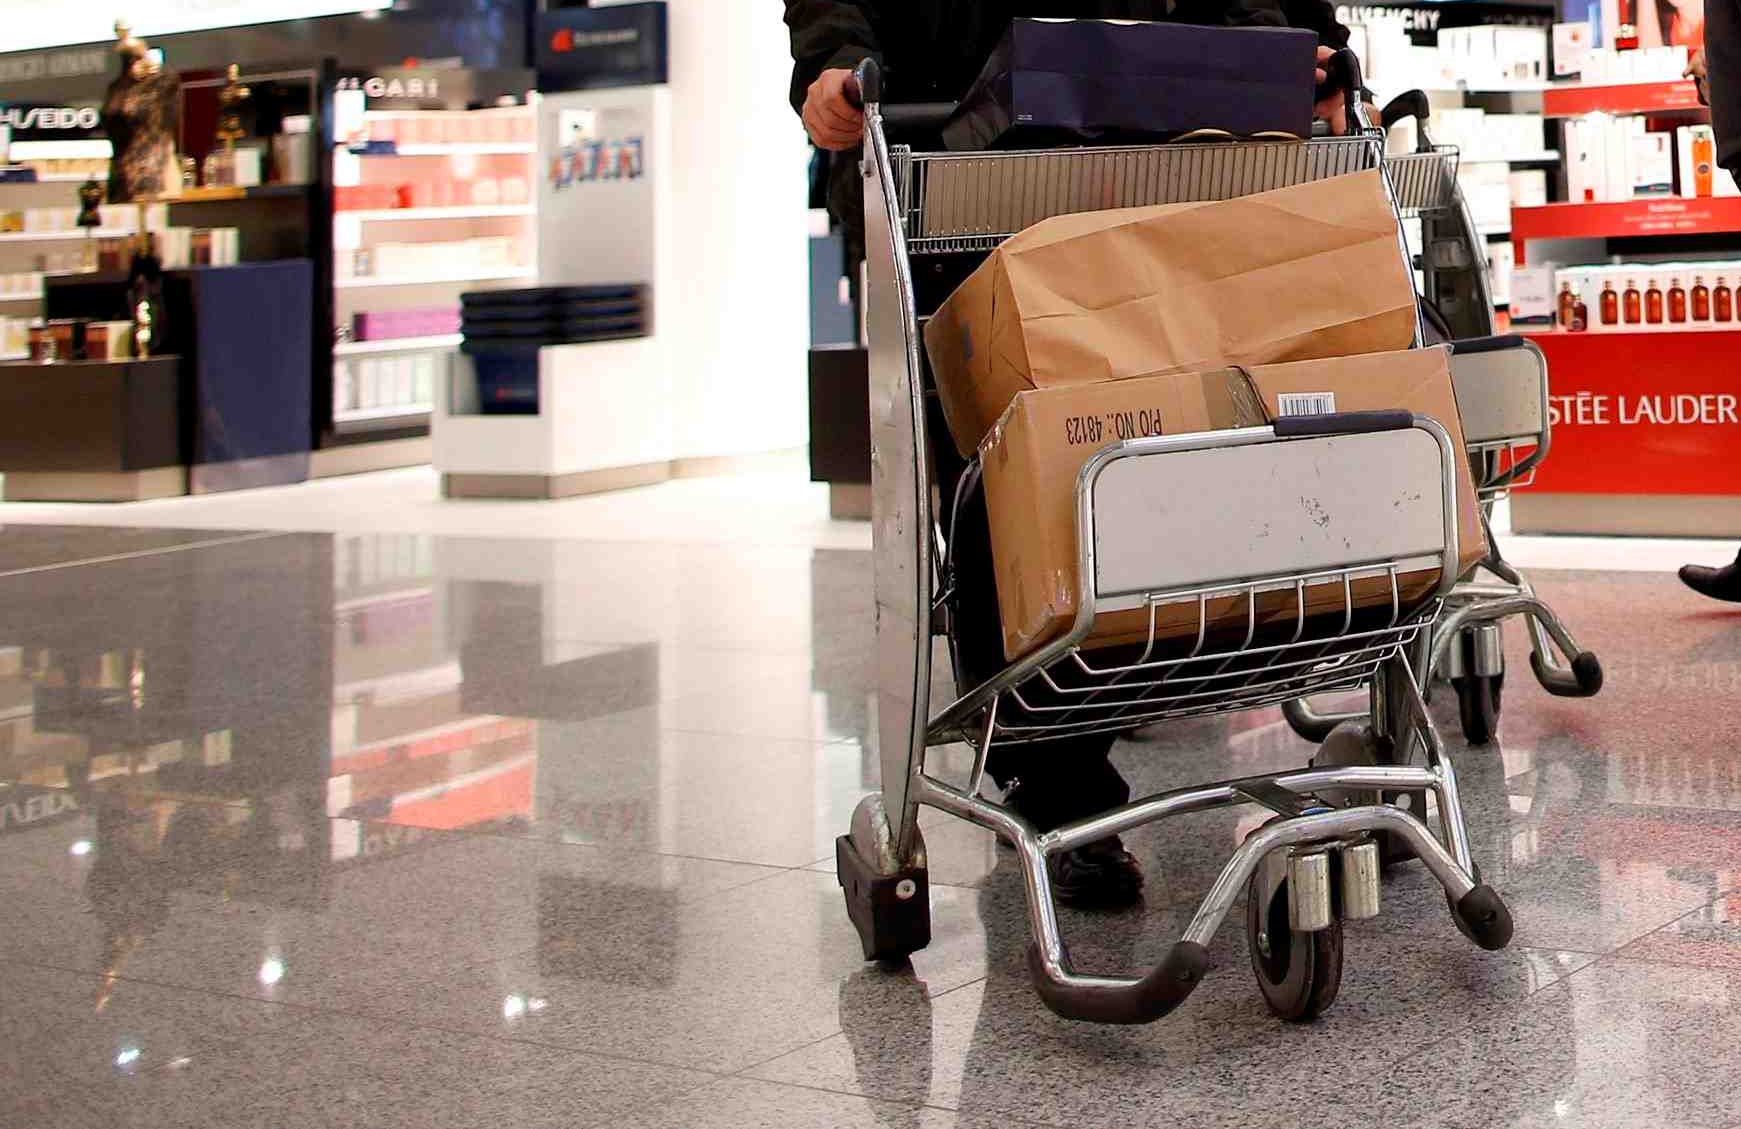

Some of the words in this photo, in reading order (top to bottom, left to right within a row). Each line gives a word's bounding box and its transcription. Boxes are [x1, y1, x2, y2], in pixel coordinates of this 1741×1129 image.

[0, 107, 98, 129] HISEIDO
[1618, 394, 1740, 425] LAUDER
[1065, 416, 1103, 445] 48123
